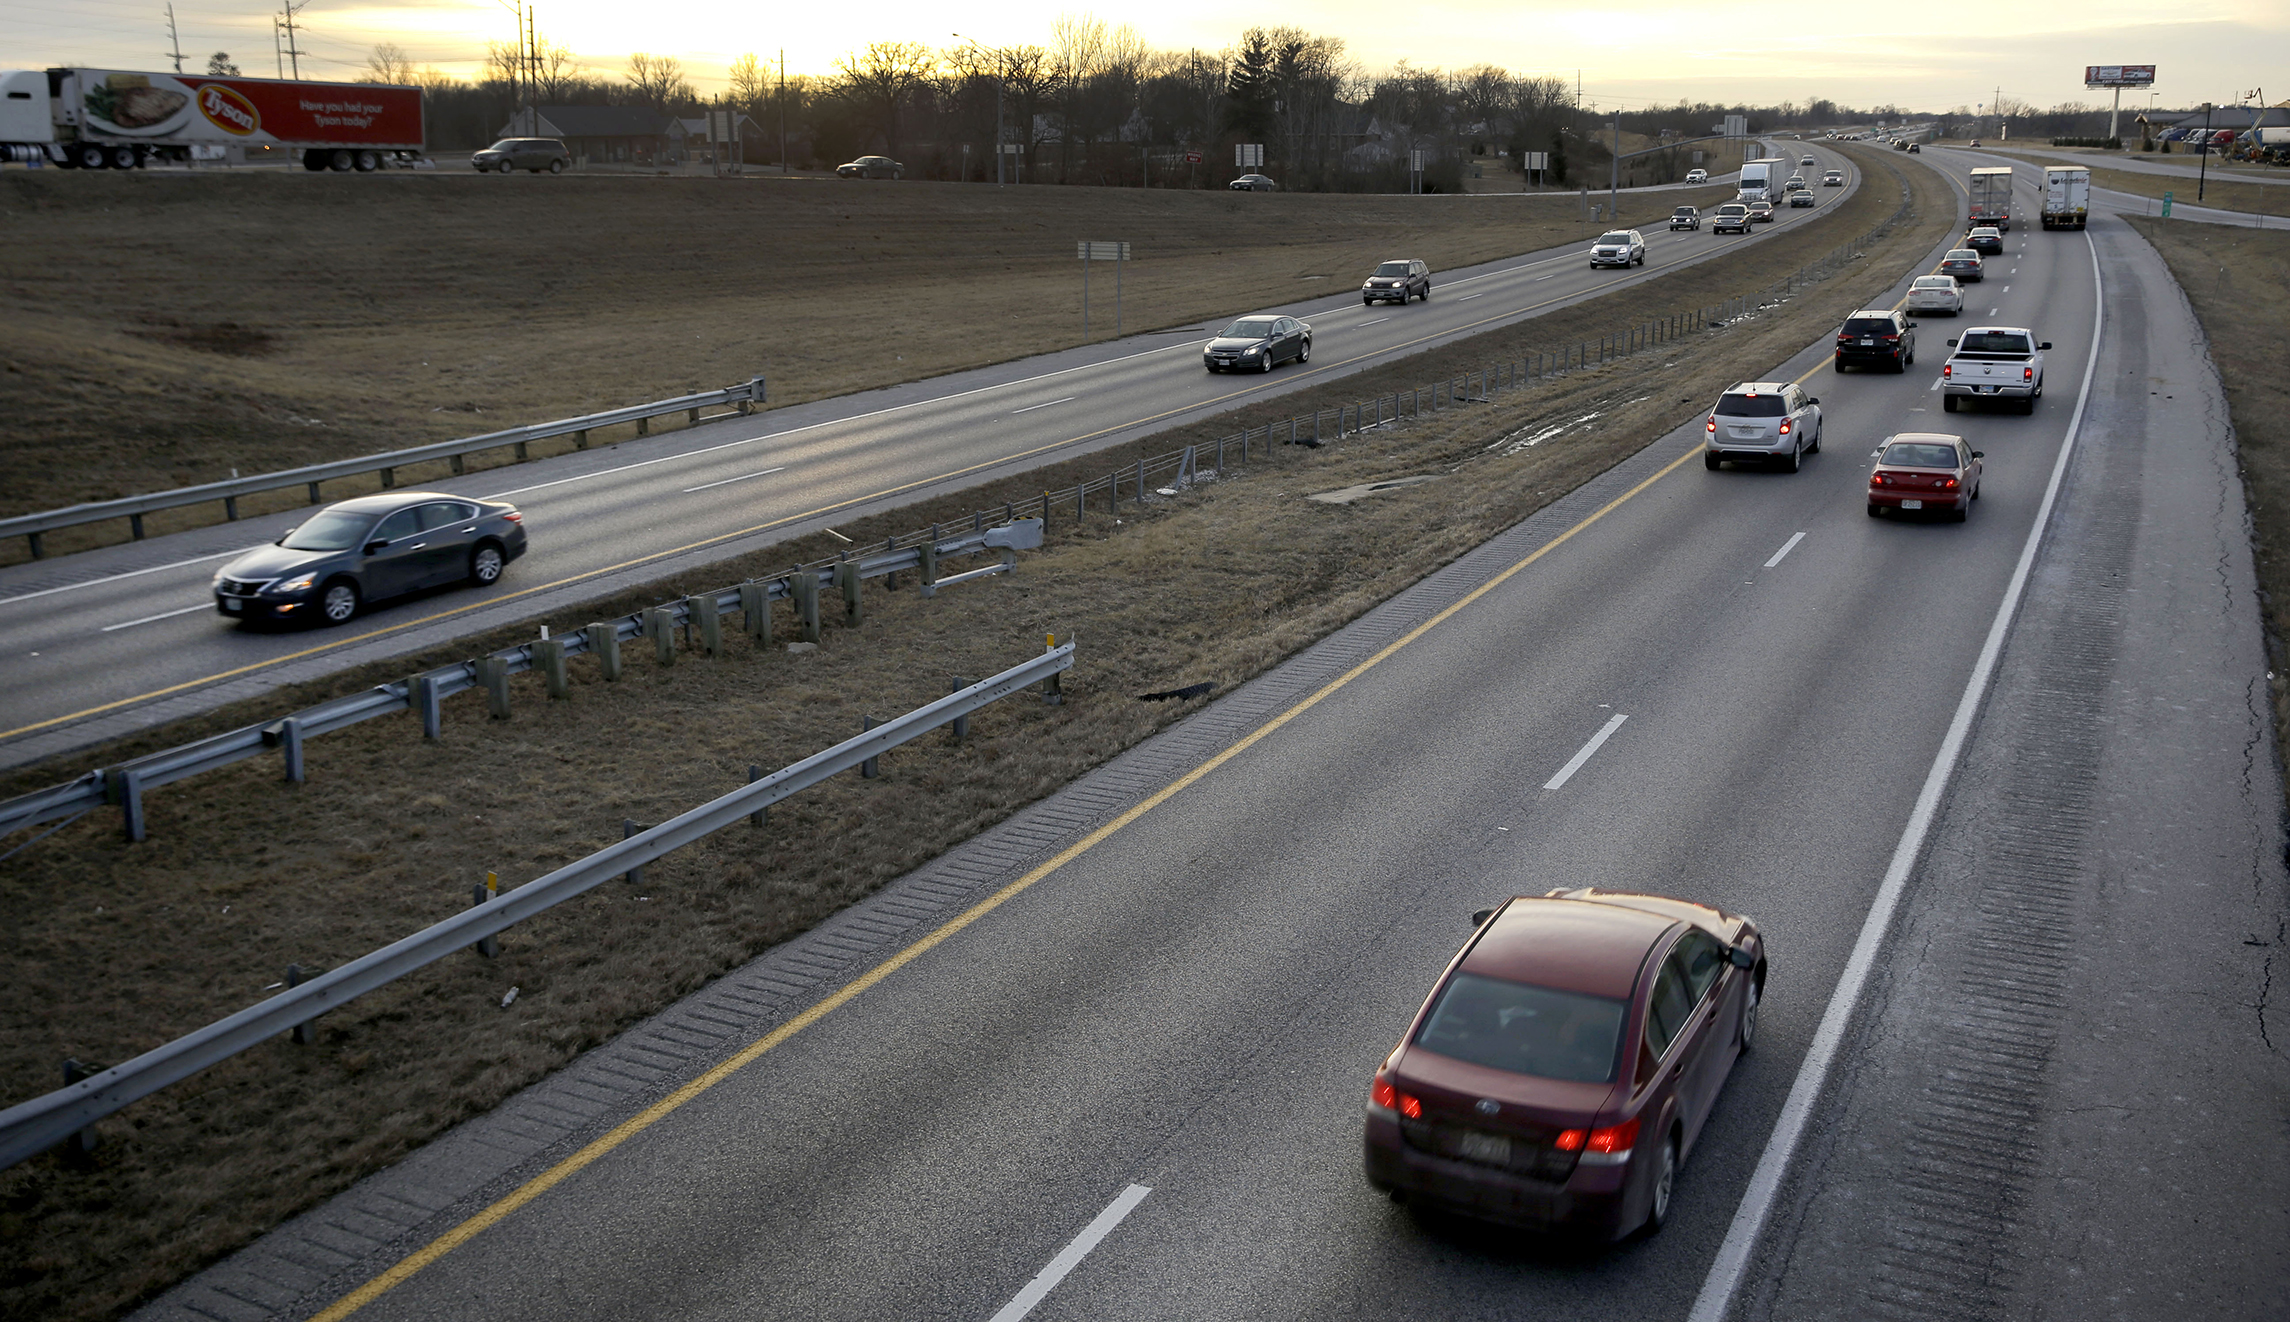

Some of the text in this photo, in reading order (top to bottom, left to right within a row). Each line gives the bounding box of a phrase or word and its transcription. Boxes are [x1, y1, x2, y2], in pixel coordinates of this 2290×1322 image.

[204, 87, 254, 130] Tyson
[300, 100, 384, 115] Have you had your
[314, 114, 373, 129] Tyson today?
